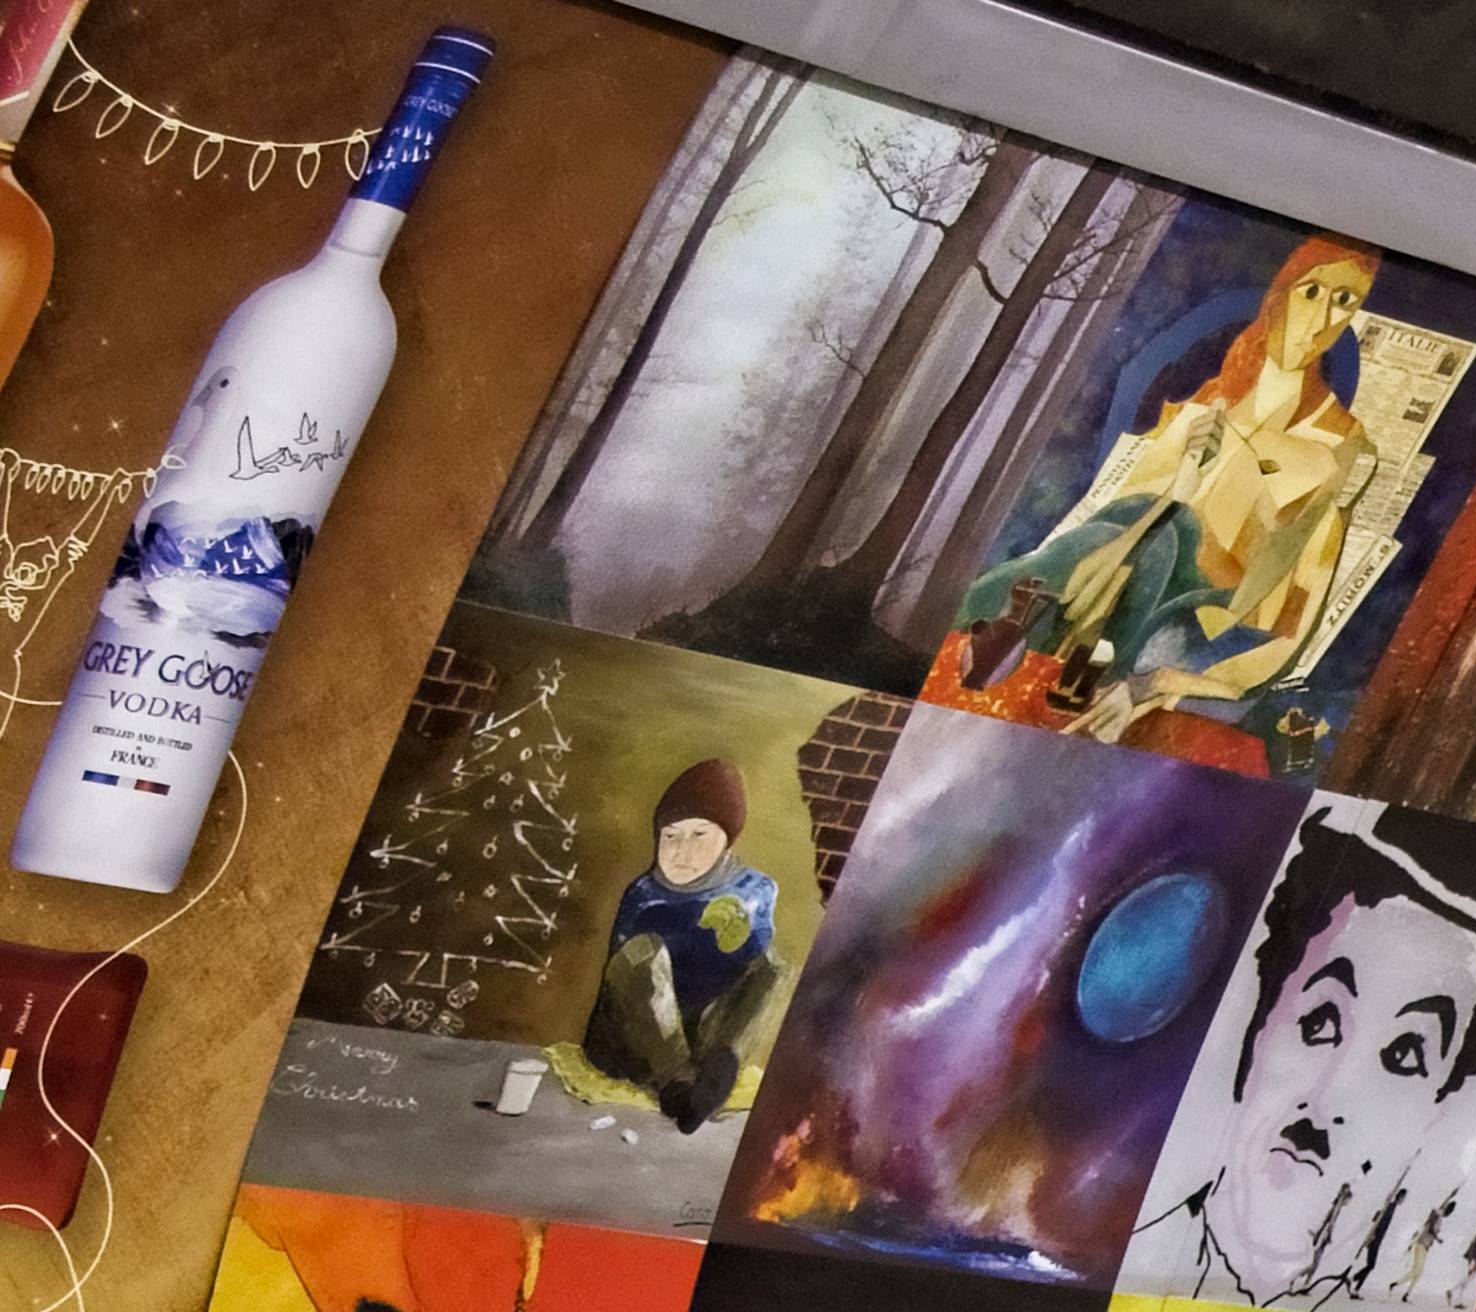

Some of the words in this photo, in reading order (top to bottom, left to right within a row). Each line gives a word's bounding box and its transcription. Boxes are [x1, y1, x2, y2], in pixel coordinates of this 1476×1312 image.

[84, 641, 154, 677] GREY
[158, 653, 254, 700] GOOSE
[109, 689, 201, 725] VODKA
[136, 732, 157, 744] AND
[110, 750, 158, 768] FRANCE
